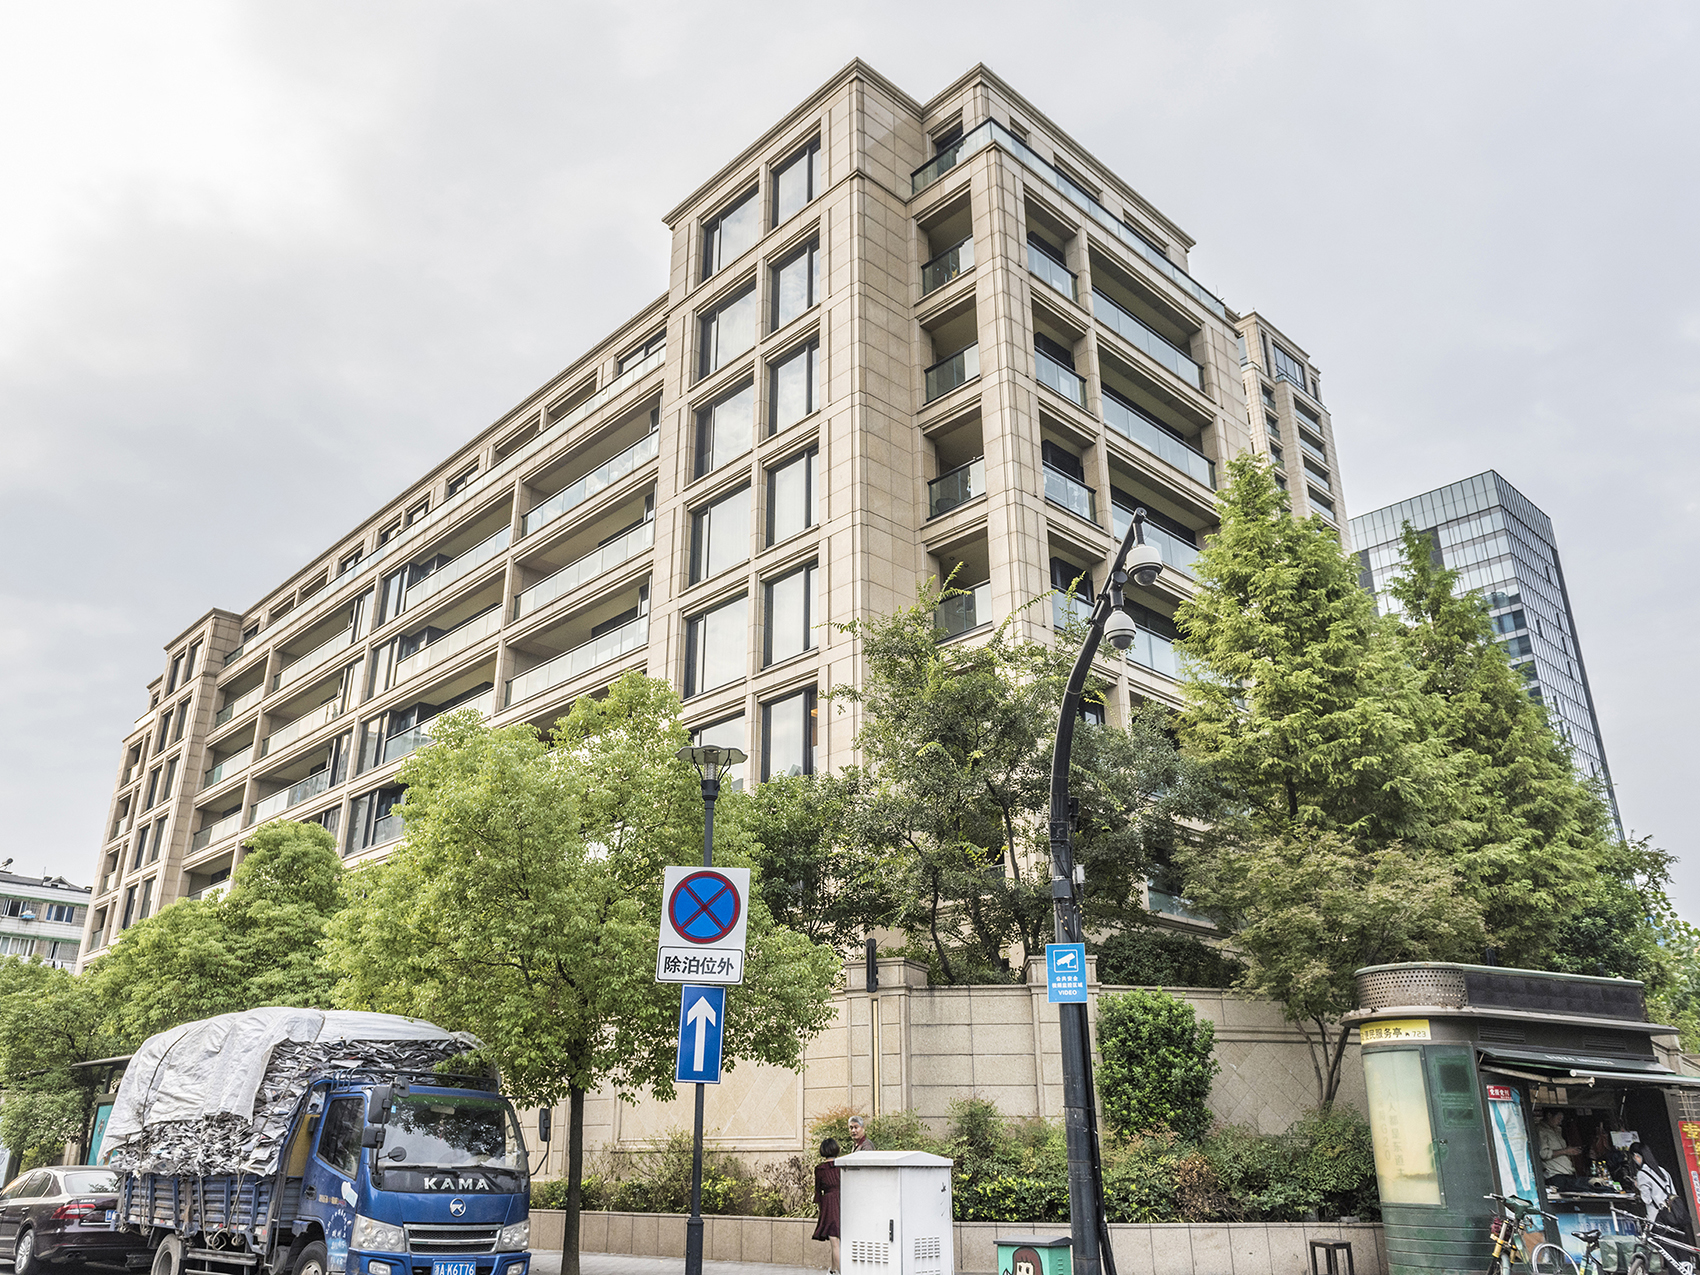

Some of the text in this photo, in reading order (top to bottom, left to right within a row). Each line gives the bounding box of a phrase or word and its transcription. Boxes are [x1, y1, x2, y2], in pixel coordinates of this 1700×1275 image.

[663, 955, 735, 976] 除泊位外
[423, 1177, 490, 1191] KAMA
